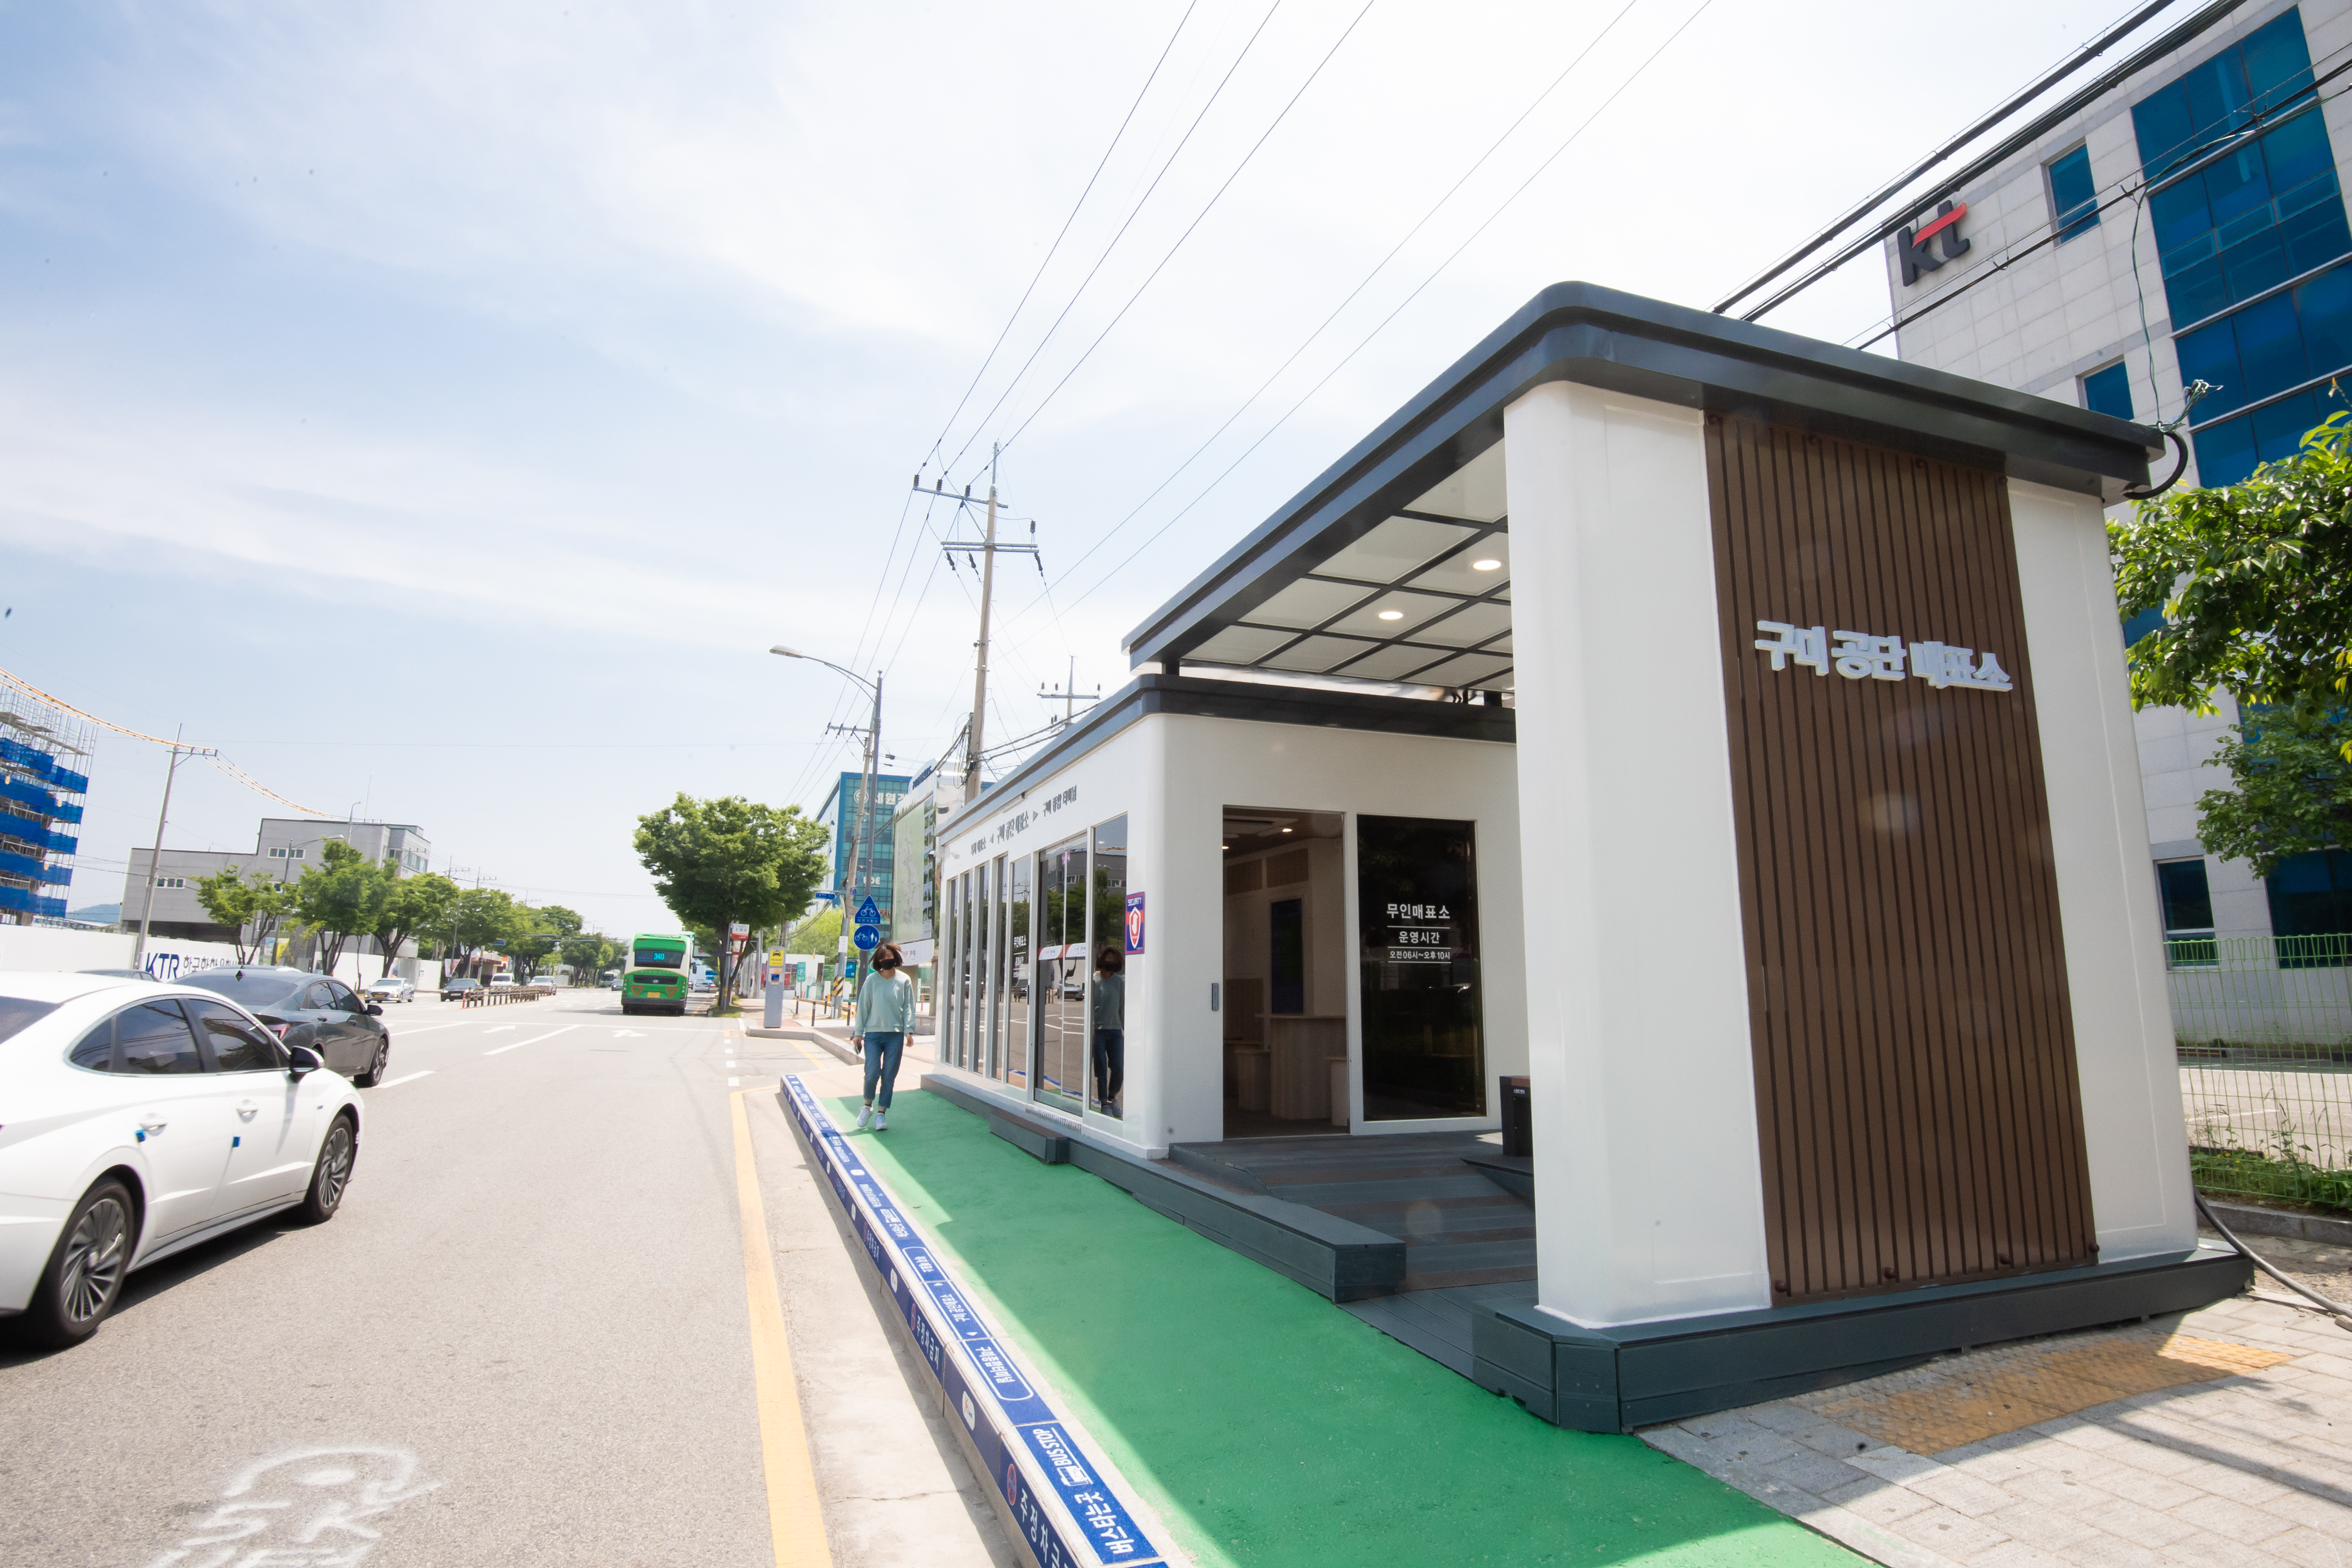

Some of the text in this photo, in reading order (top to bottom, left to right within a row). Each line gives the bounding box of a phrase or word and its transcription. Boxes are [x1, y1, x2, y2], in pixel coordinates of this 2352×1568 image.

[1755, 620, 2013, 692] 구미 공단 매표소
[1052, 794, 1062, 812] 종합
[1063, 785, 1077, 805] 터미널
[1006, 818, 1015, 841] 공단
[1015, 810, 1029, 834] 매표소
[1128, 897, 1142, 907] SECURITY
[1387, 904, 1450, 919] 무인매표소
[1399, 931, 1440, 944] 운영시간
[145, 952, 179, 979] KTR
[917, 1315, 939, 1371] 주정차금지
[975, 1346, 1015, 1384] 구미종합터미널
[1033, 1428, 1073, 1466] BUS STOP
[1020, 1488, 1070, 1568] 주정차금
[1074, 1492, 1134, 1554] 버스타는곳
